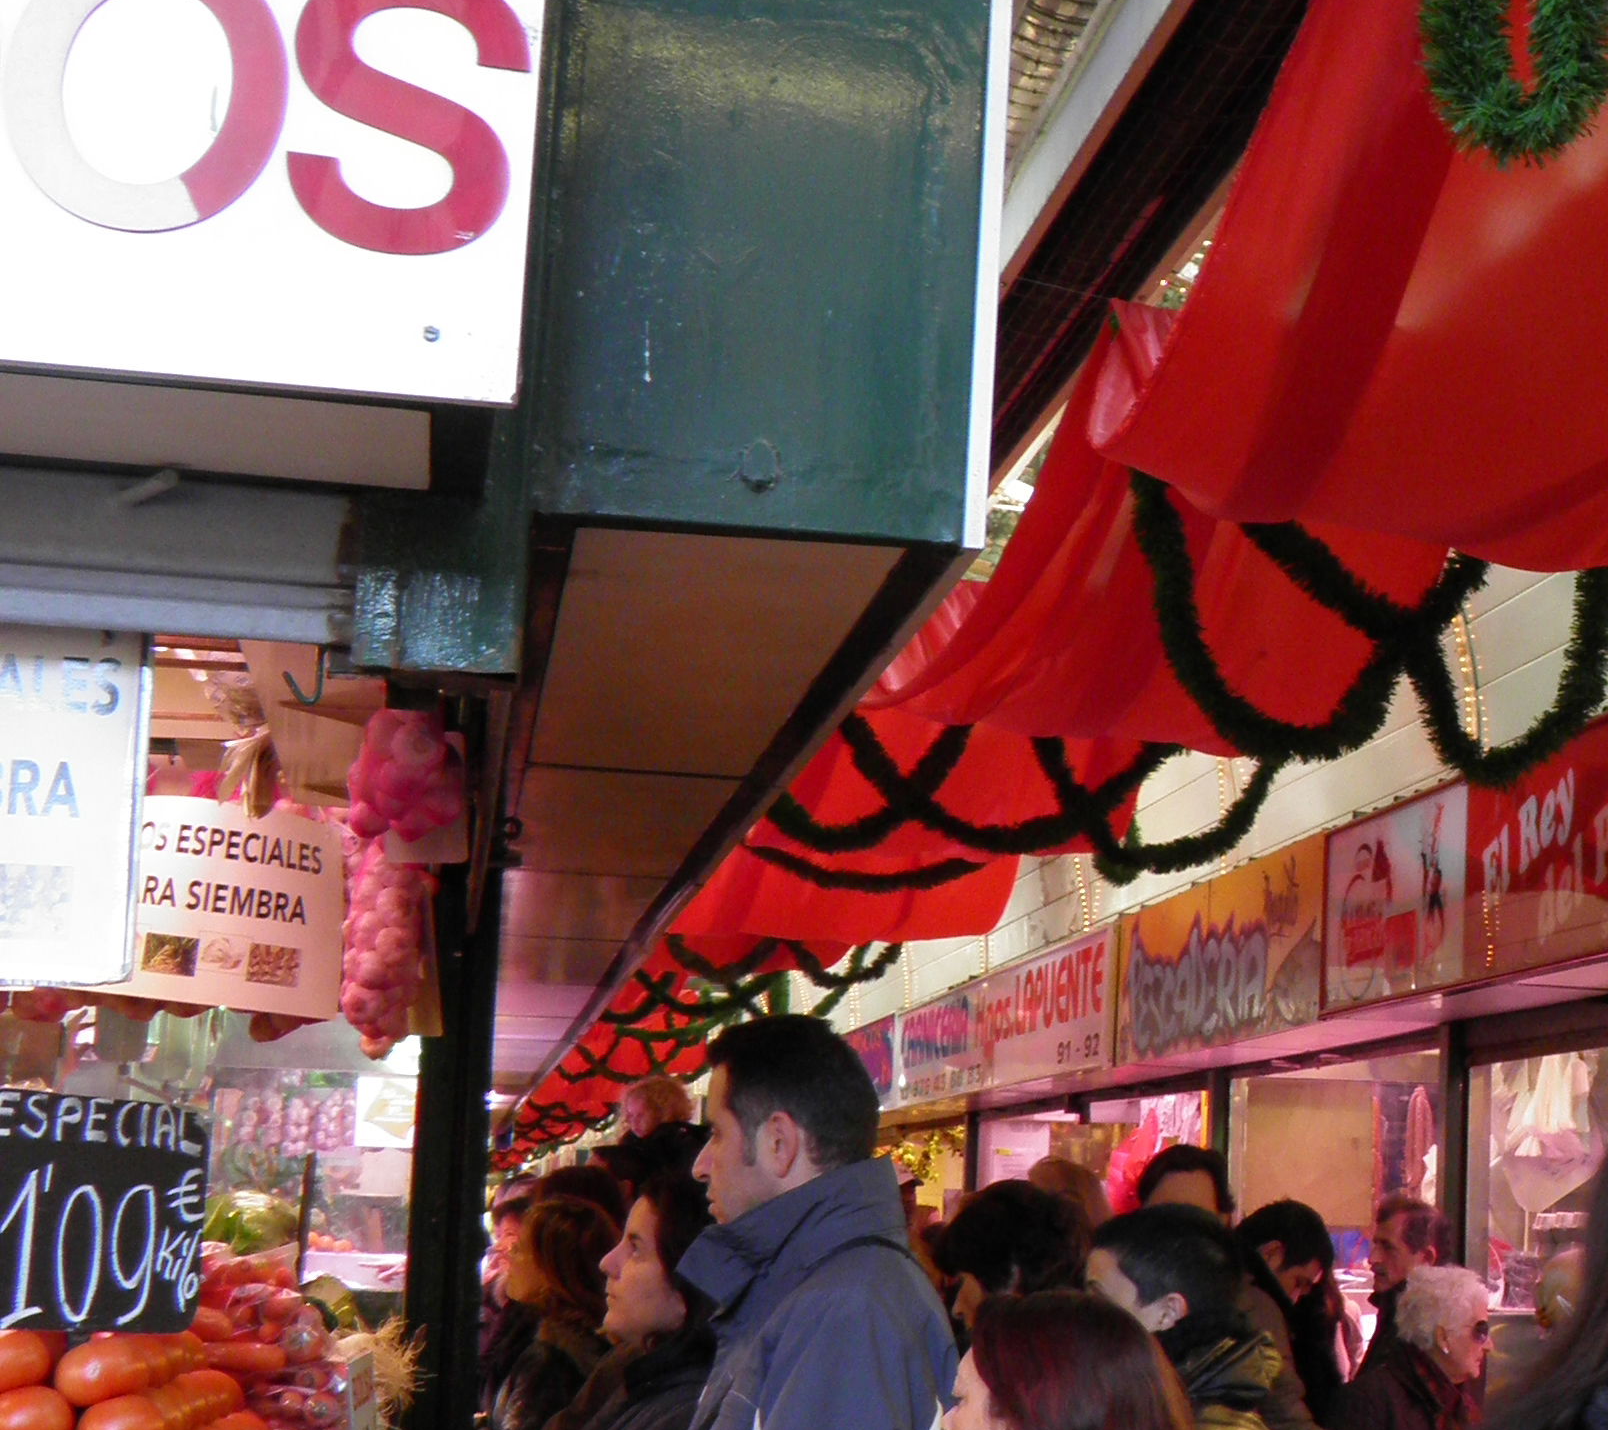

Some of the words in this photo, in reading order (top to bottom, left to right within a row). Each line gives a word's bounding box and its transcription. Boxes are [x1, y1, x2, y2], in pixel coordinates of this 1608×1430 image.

[0, 759, 81, 818] RA
[175, 824, 323, 875] ESPECIALES
[1518, 767, 1576, 875] Rey
[137, 873, 177, 908] RA
[185, 880, 307, 925] SIEMBRA
[1537, 832, 1584, 945] del
[1015, 942, 1105, 1036] LAPUENTE
[1057, 1040, 1072, 1065] 91
[1084, 1032, 1100, 1058] 92
[0, 1092, 203, 1158] ESPECIAL
